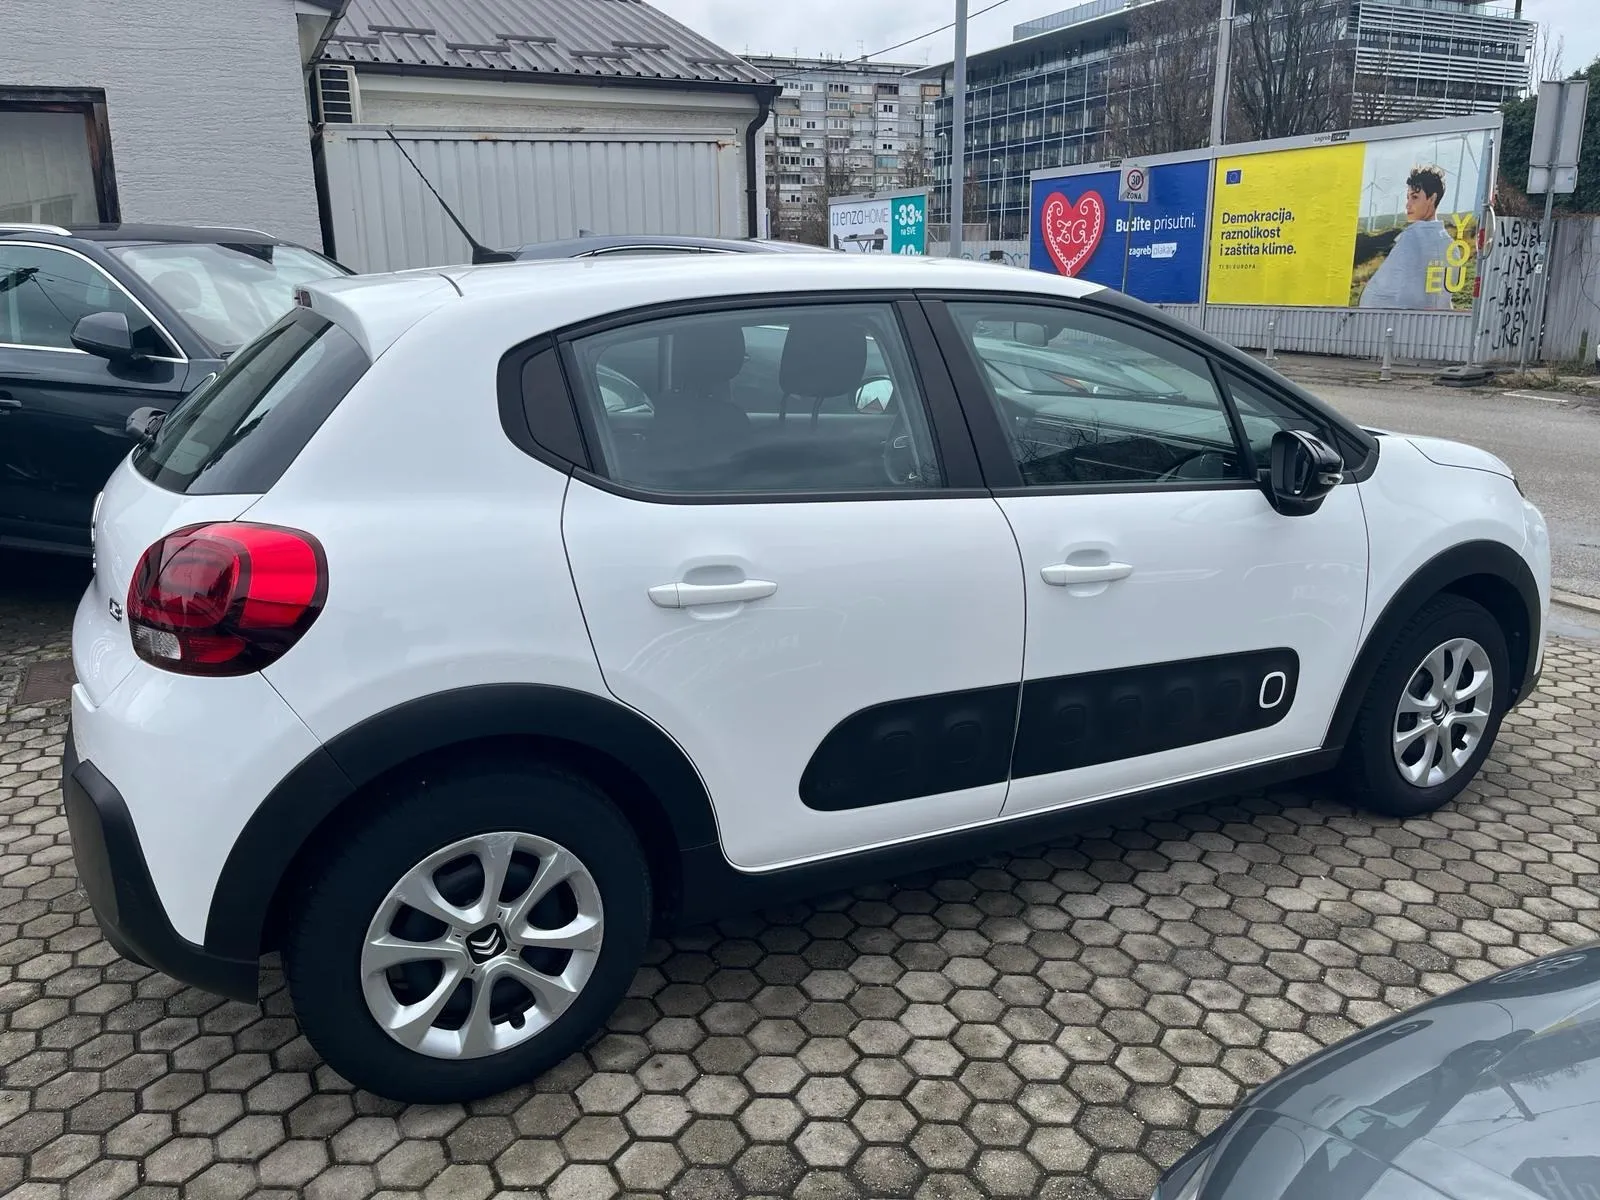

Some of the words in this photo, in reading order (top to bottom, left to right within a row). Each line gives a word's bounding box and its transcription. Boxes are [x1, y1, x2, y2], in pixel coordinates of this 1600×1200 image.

[1131, 175, 1141, 186] 30
[1126, 191, 1142, 200] ZONA
[895, 204, 923, 225] -33%
[1115, 216, 1151, 233] Budite
[1153, 212, 1196, 234] prisutni.
[1222, 207, 1295, 225] Demokracija,
[1056, 219, 1088, 244] ZG
[1221, 226, 1281, 241] raznolikost
[1219, 243, 1223, 257] i
[1224, 242, 1260, 256] zaštita
[1261, 241, 1297, 256] klime.
